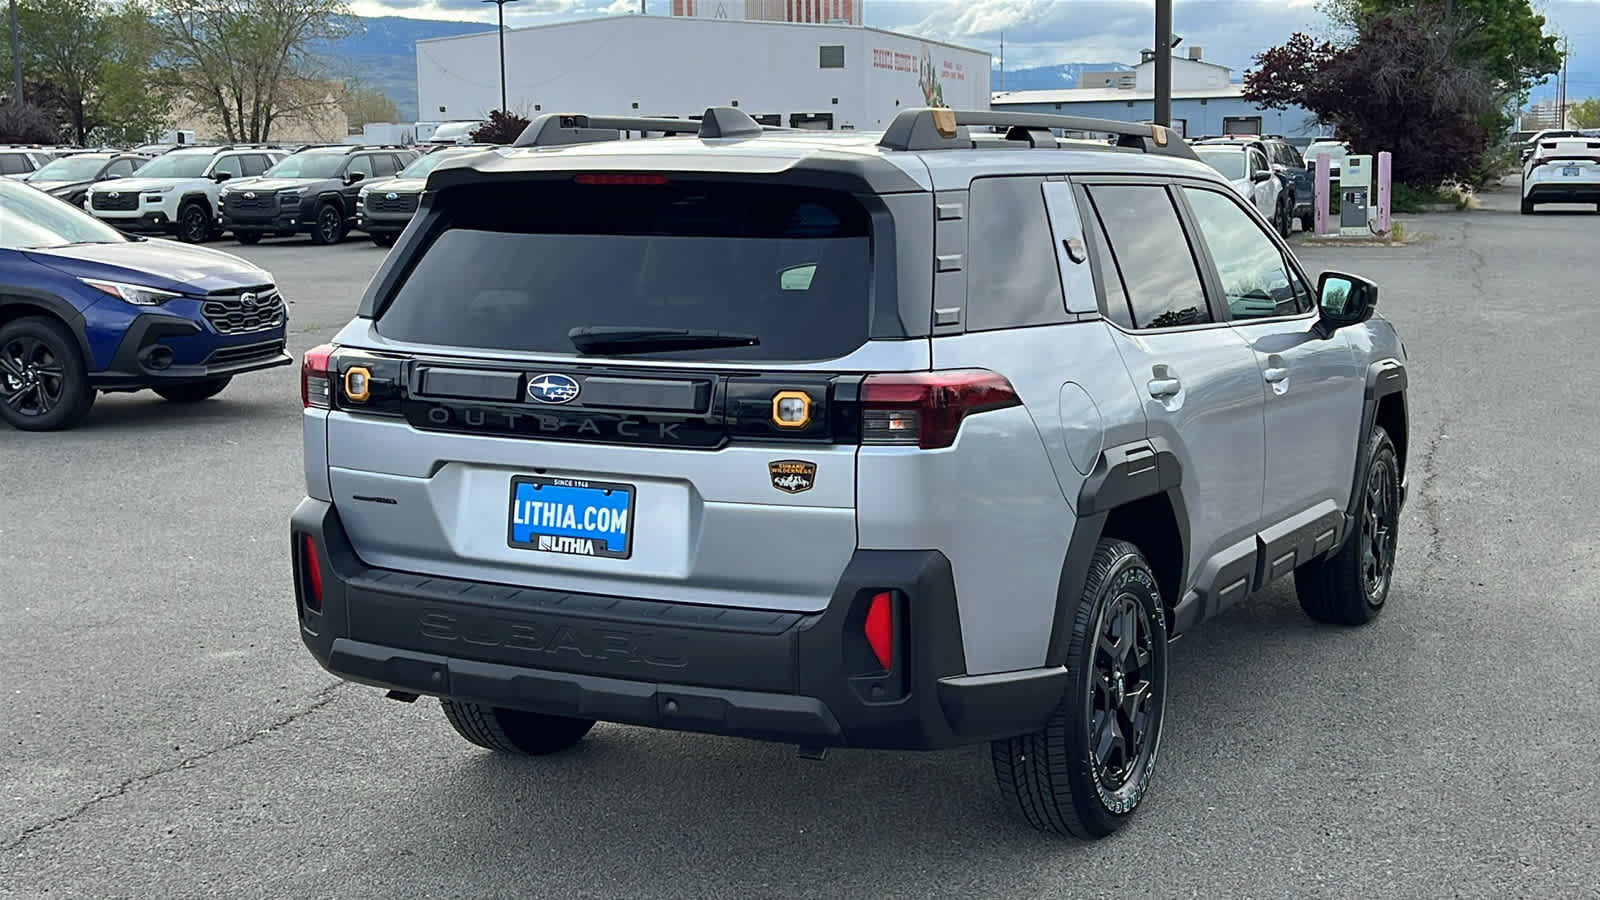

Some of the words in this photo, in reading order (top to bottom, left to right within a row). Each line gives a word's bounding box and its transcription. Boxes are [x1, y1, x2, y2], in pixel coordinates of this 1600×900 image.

[428, 407, 680, 439] OUTBACK
[553, 479, 573, 487] SINCE
[513, 499, 628, 534] LITHIA.COM
[551, 536, 594, 555] LITHIA
[418, 610, 689, 668] SUBARU
